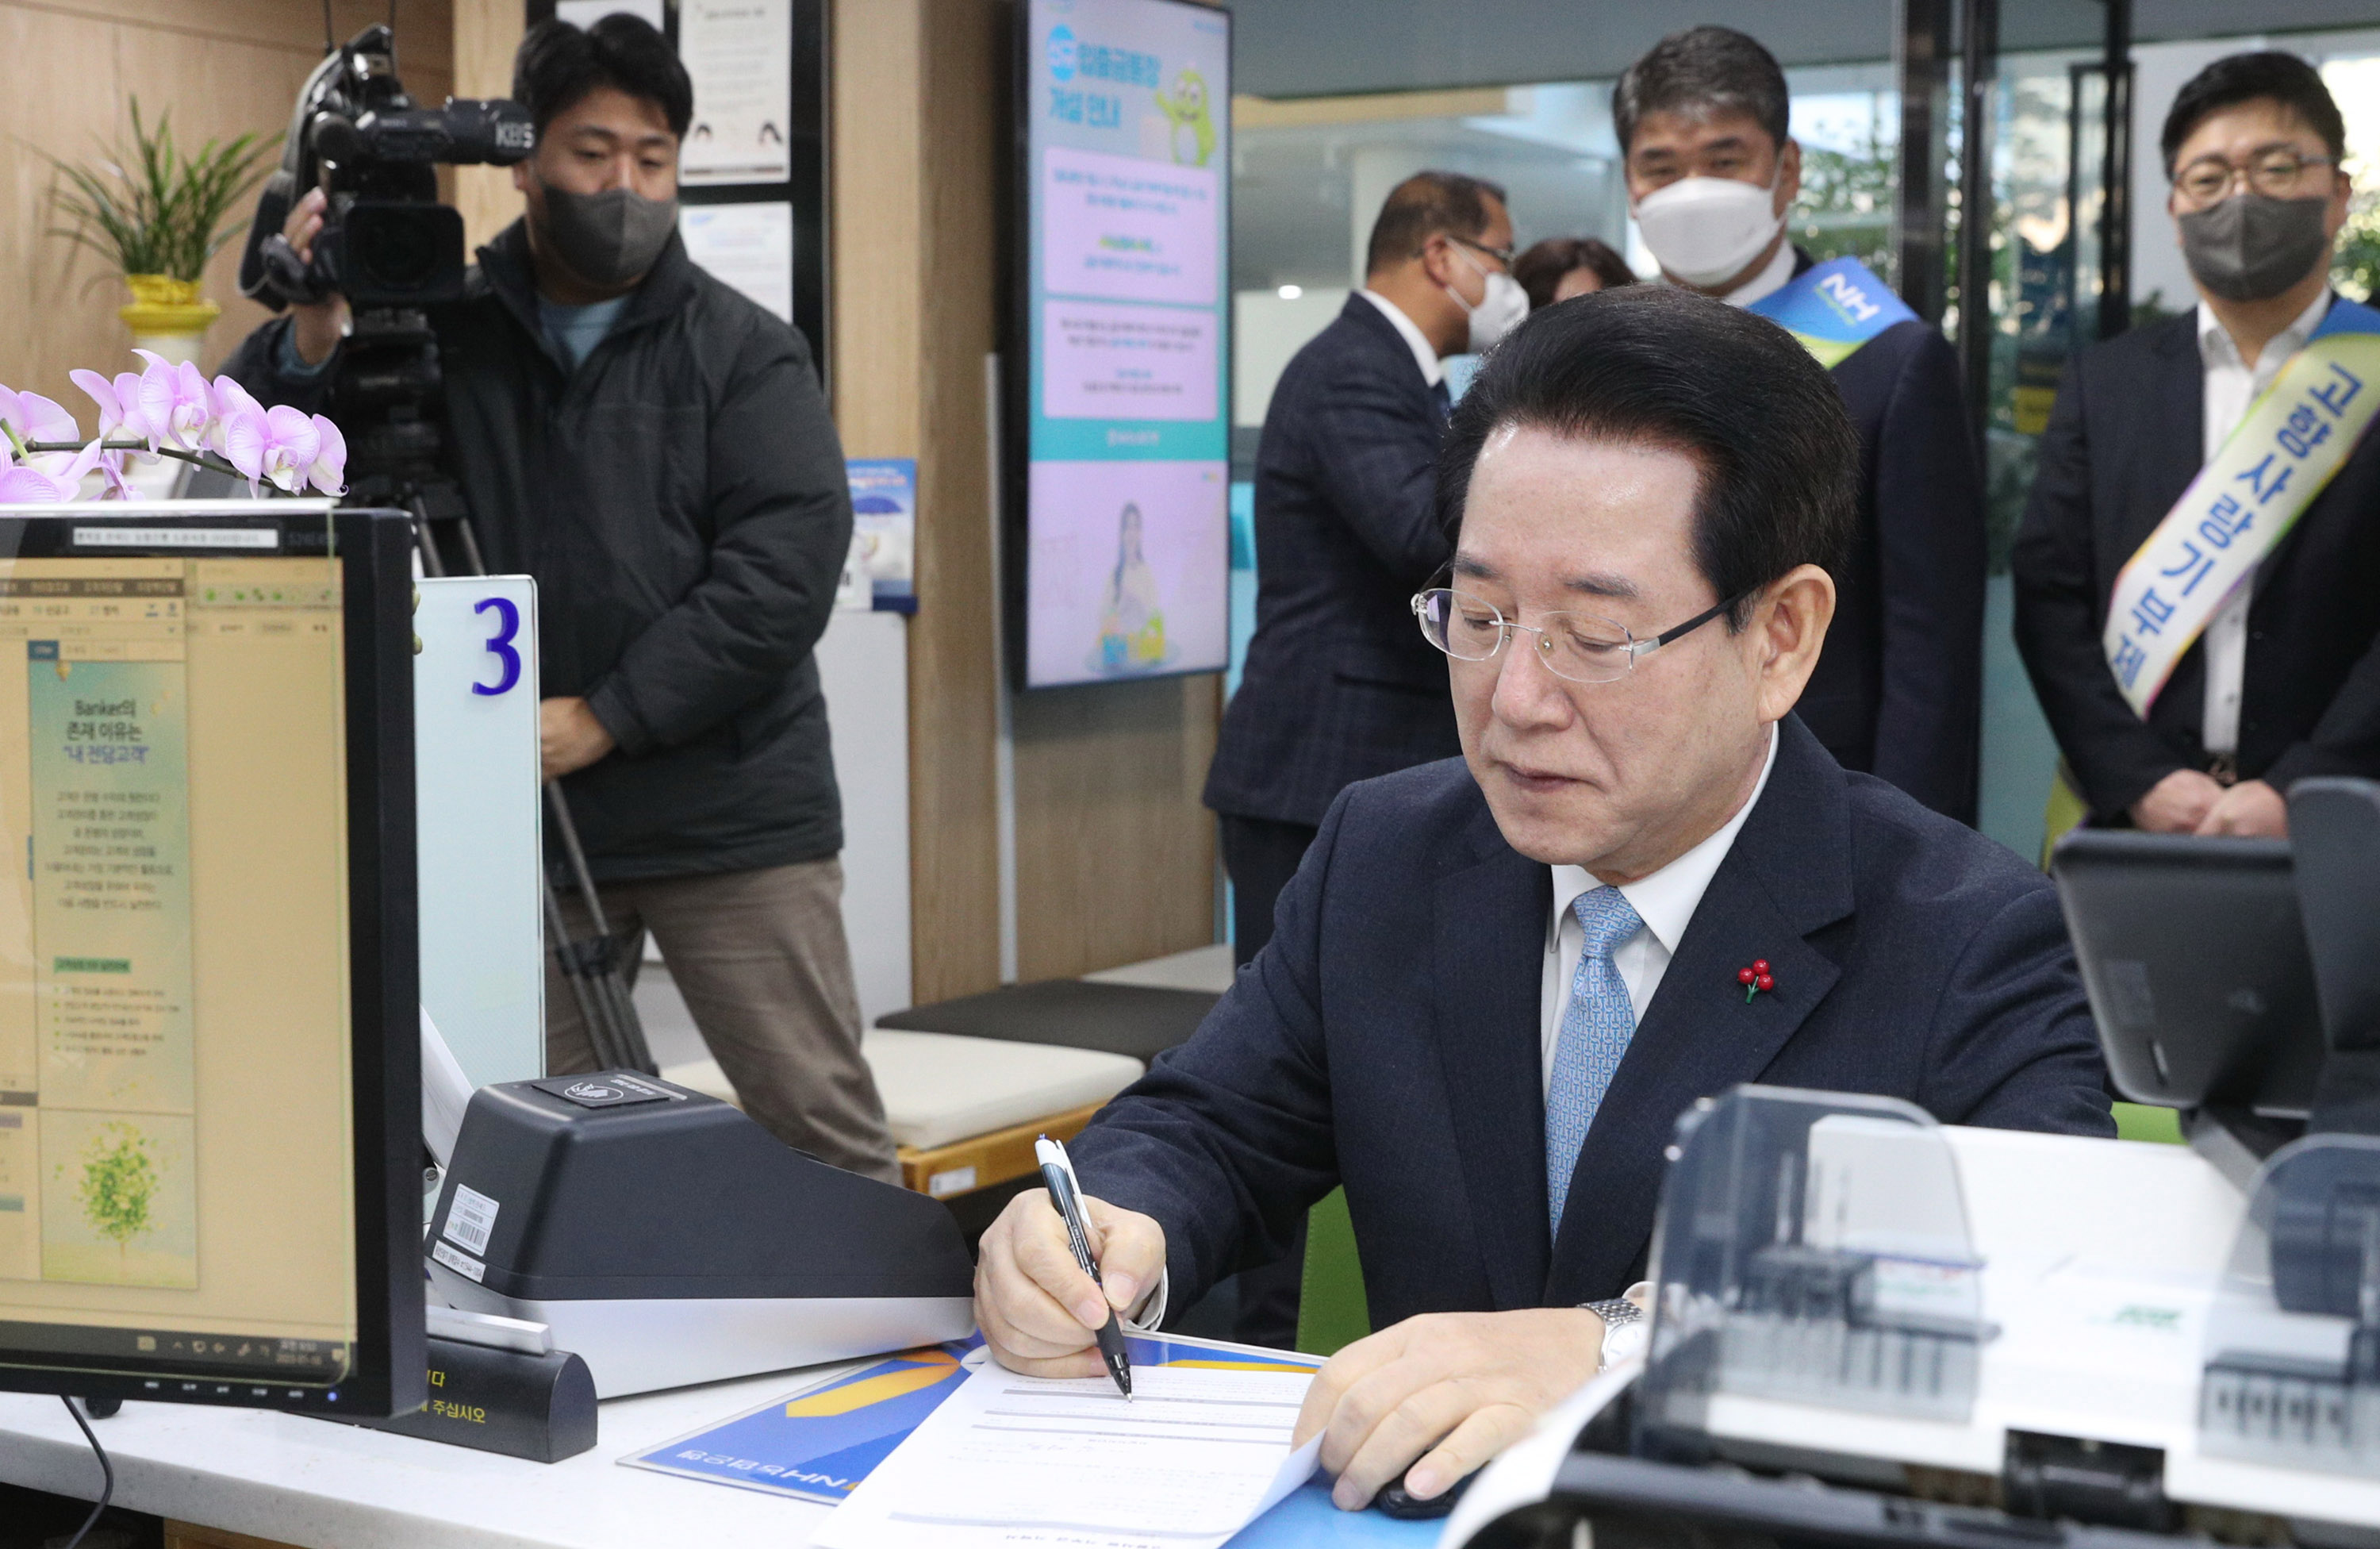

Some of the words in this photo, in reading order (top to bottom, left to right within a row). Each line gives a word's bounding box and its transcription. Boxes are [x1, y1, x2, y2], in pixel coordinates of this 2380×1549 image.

[496, 121, 535, 148] KBS
[1820, 273, 1880, 321] NH
[472, 598, 520, 695] 3
[98, 721, 142, 741] 이유는
[433, 1400, 486, 1424] 주십시오
